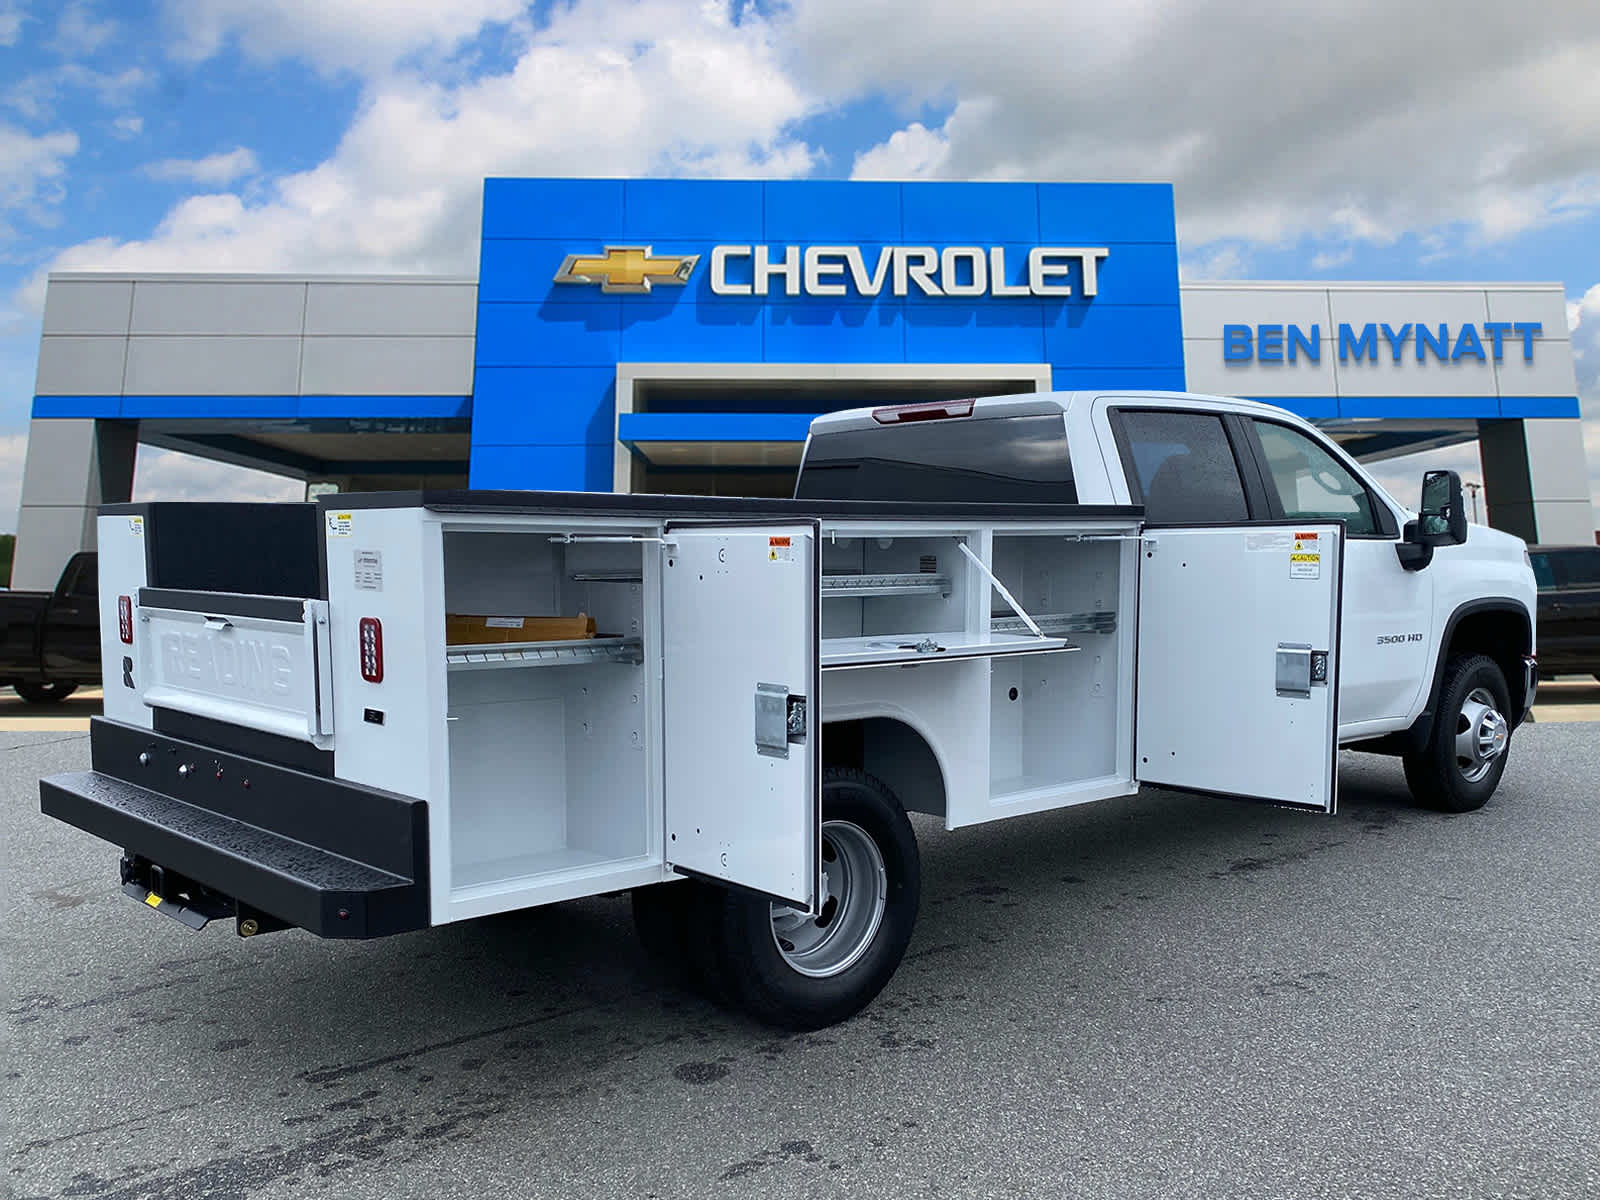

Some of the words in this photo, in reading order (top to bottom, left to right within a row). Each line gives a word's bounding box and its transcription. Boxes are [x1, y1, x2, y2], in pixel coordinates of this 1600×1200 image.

[710, 245, 1110, 297] CHEVROLET
[1223, 324, 1321, 365] BEN
[1337, 321, 1543, 365] MYNATT
[1377, 635, 1405, 645] 3500
[1408, 633, 1423, 642] HD
